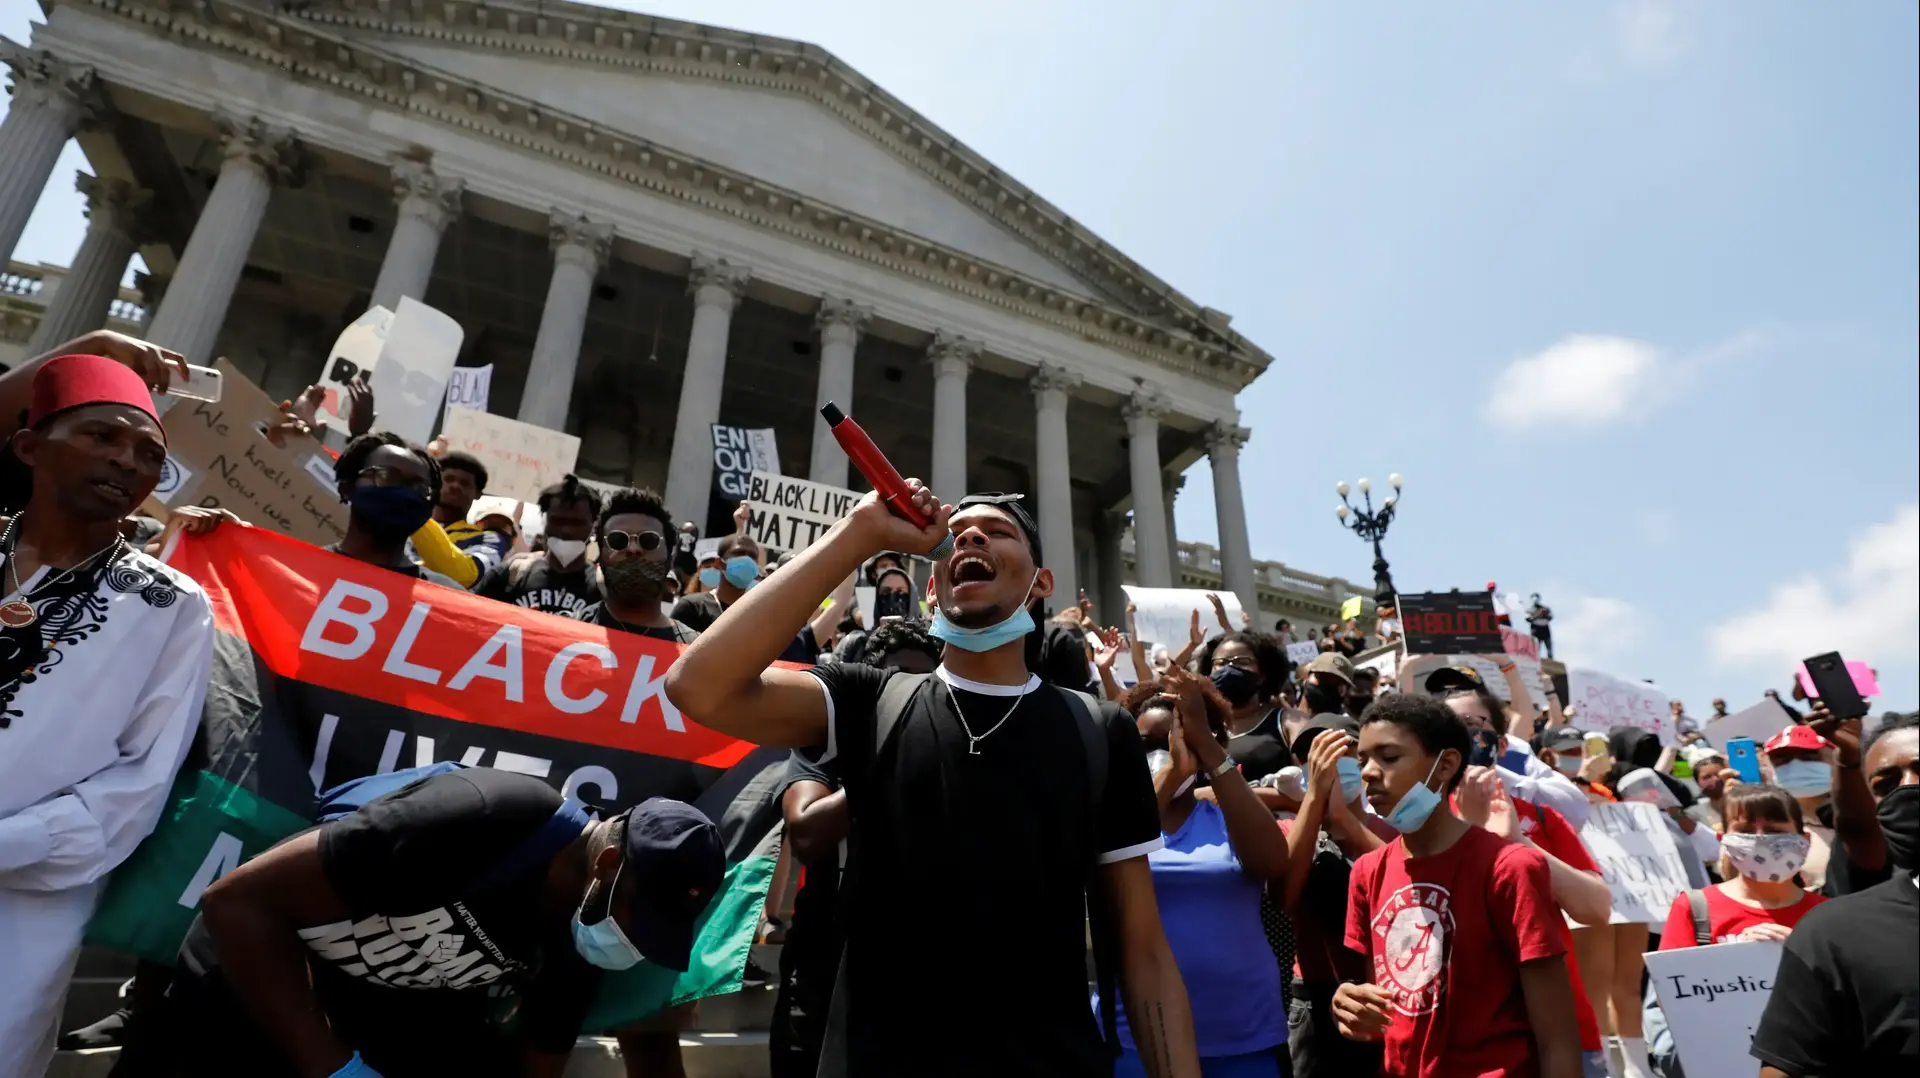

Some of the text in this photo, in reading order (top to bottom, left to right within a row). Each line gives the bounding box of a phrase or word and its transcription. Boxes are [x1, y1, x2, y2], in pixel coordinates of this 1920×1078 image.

[193, 401, 230, 438] We
[712, 424, 747, 450] EN
[714, 447, 753, 474] OU
[751, 476, 809, 512] BLACK
[262, 503, 293, 532] we
[299, 578, 688, 733] BLACK
[472, 925, 488, 942] YOU
[1666, 974, 1773, 1003] Injustic
